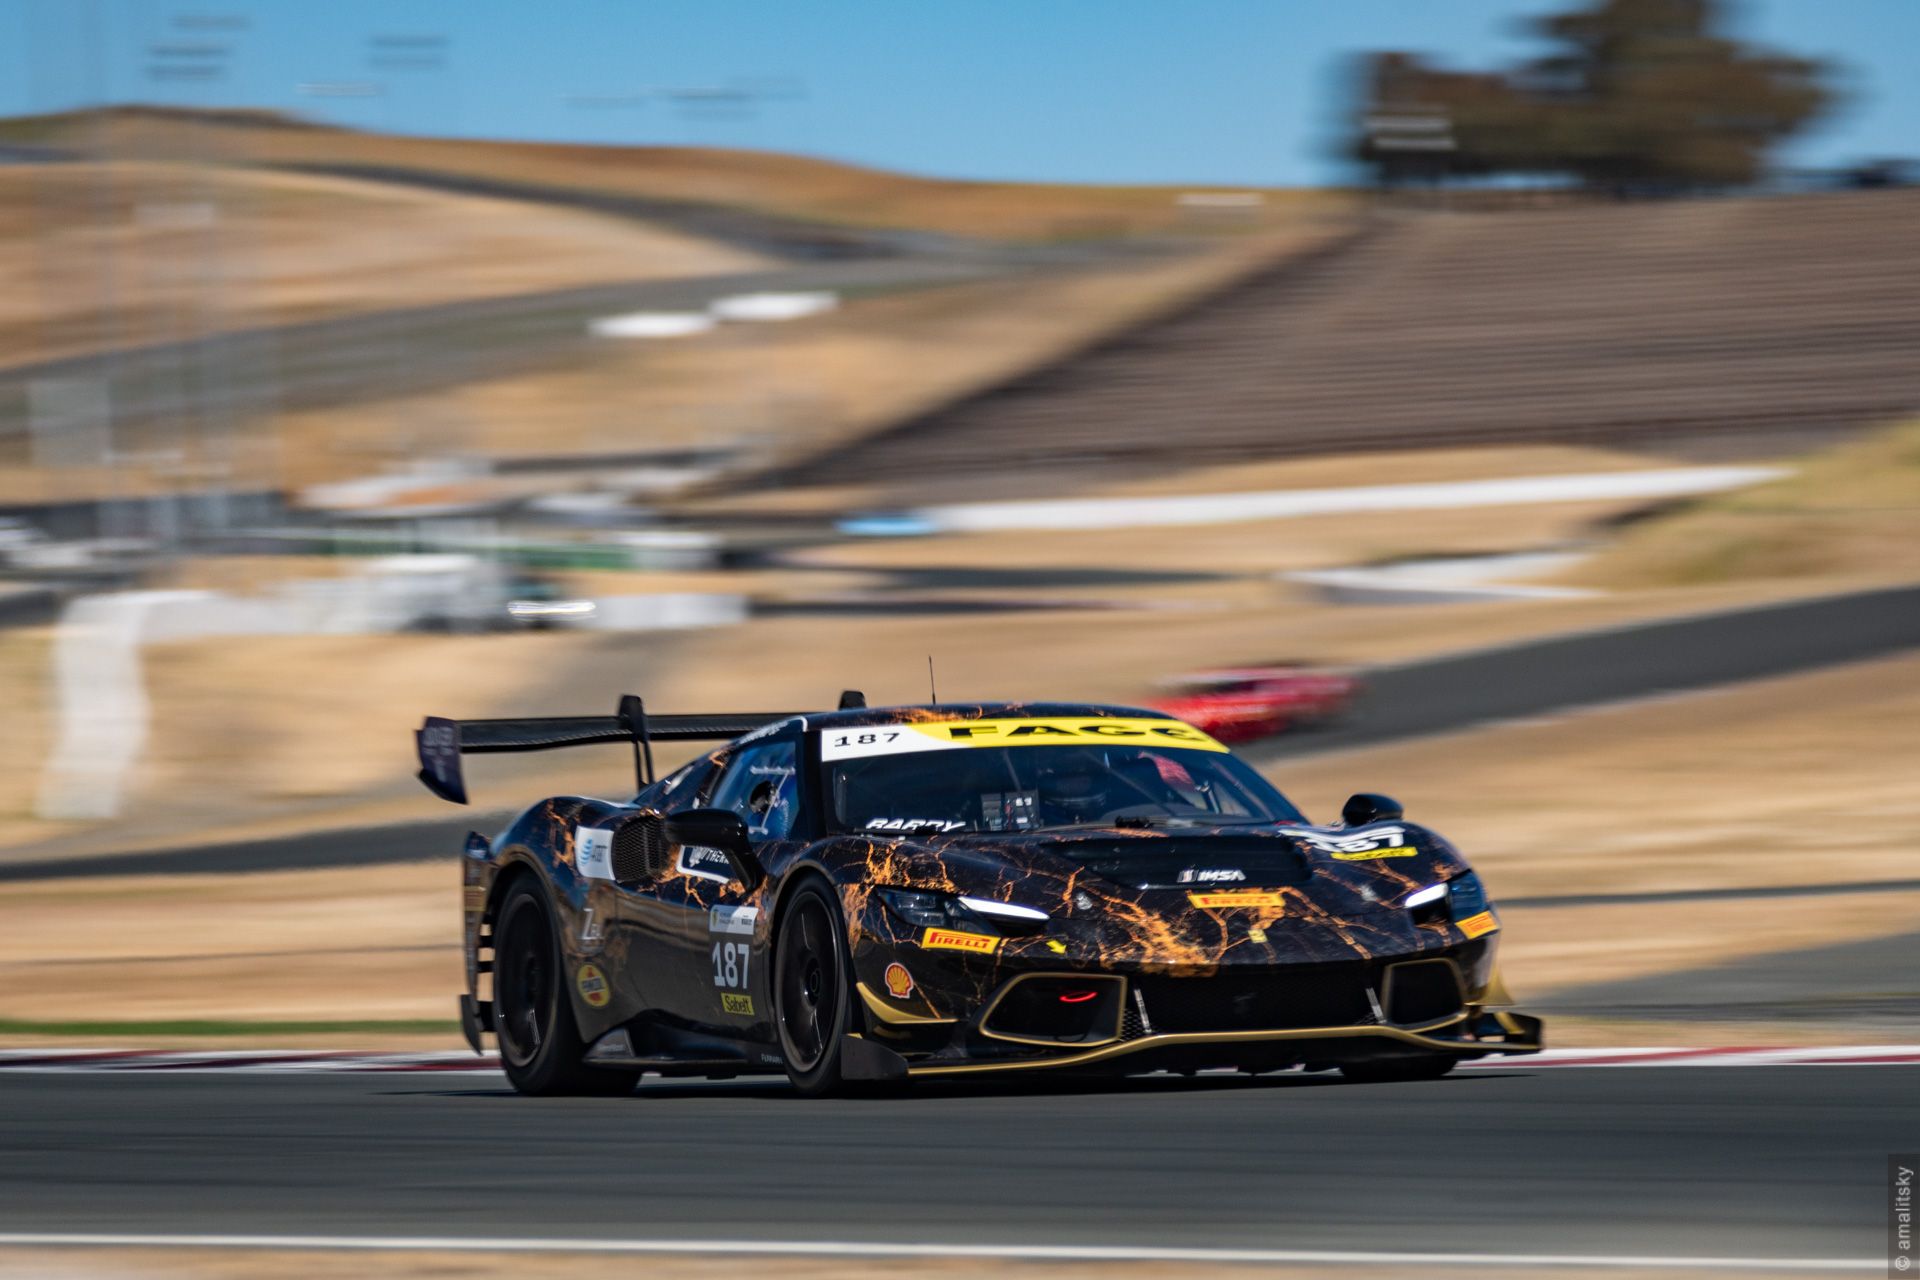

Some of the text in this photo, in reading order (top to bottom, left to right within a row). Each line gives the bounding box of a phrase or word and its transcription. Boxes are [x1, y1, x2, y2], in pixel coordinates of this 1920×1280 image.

[834, 732, 900, 747] 187
[1197, 869, 1246, 881] IMSA
[929, 931, 991, 949] PIRELLI
[712, 941, 750, 989] 187
